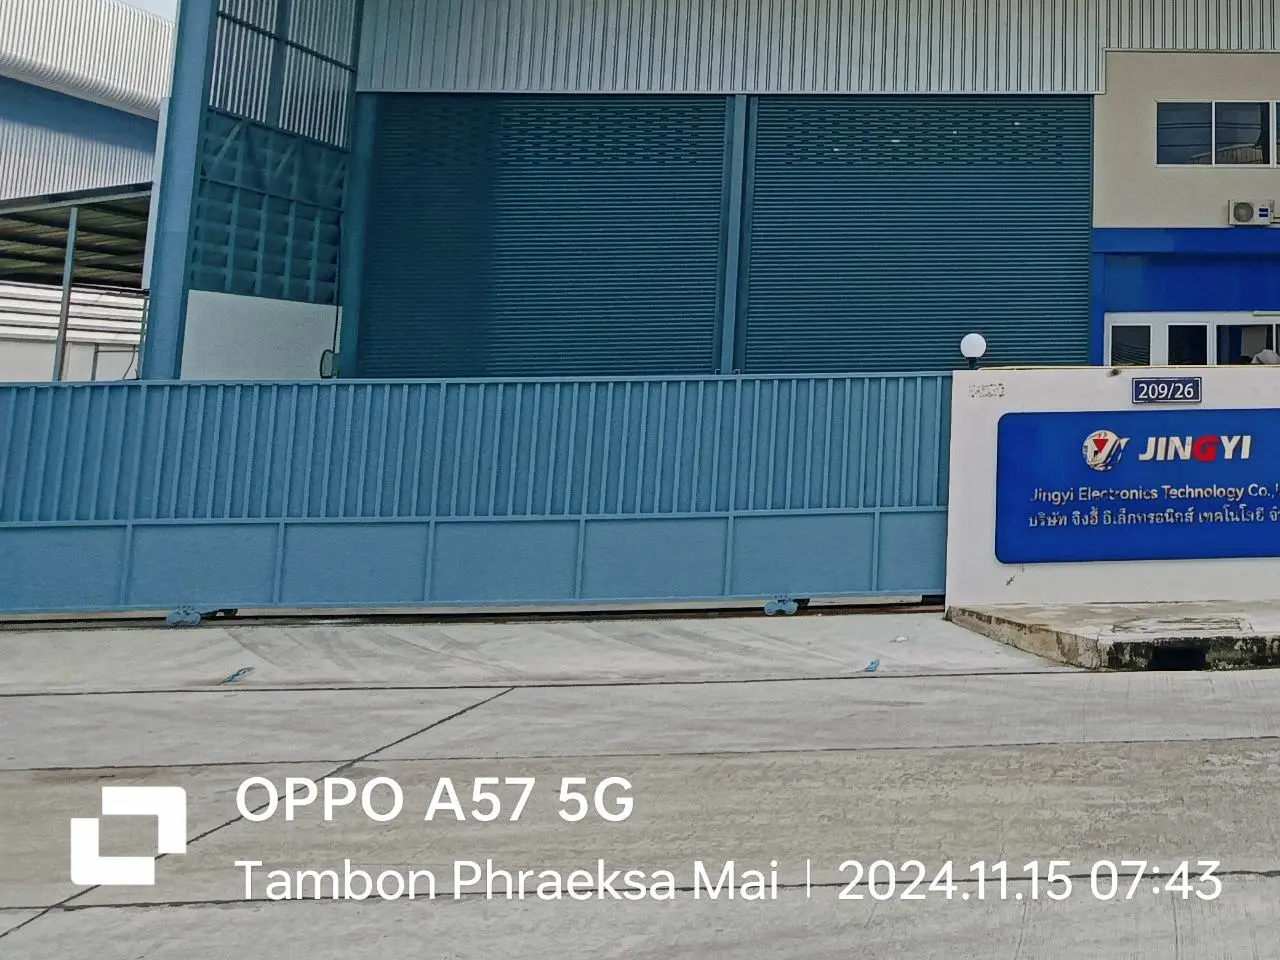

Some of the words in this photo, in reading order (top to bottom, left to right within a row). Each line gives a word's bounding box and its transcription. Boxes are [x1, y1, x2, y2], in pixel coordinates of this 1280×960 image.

[1138, 382, 1194, 399] 209/26
[1138, 434, 1252, 463] JINGYI
[1030, 486, 1075, 505] Jingyi
[1078, 484, 1158, 501] Electronics
[1160, 483, 1245, 501] Technology
[1028, 510, 1068, 527] บริษัท
